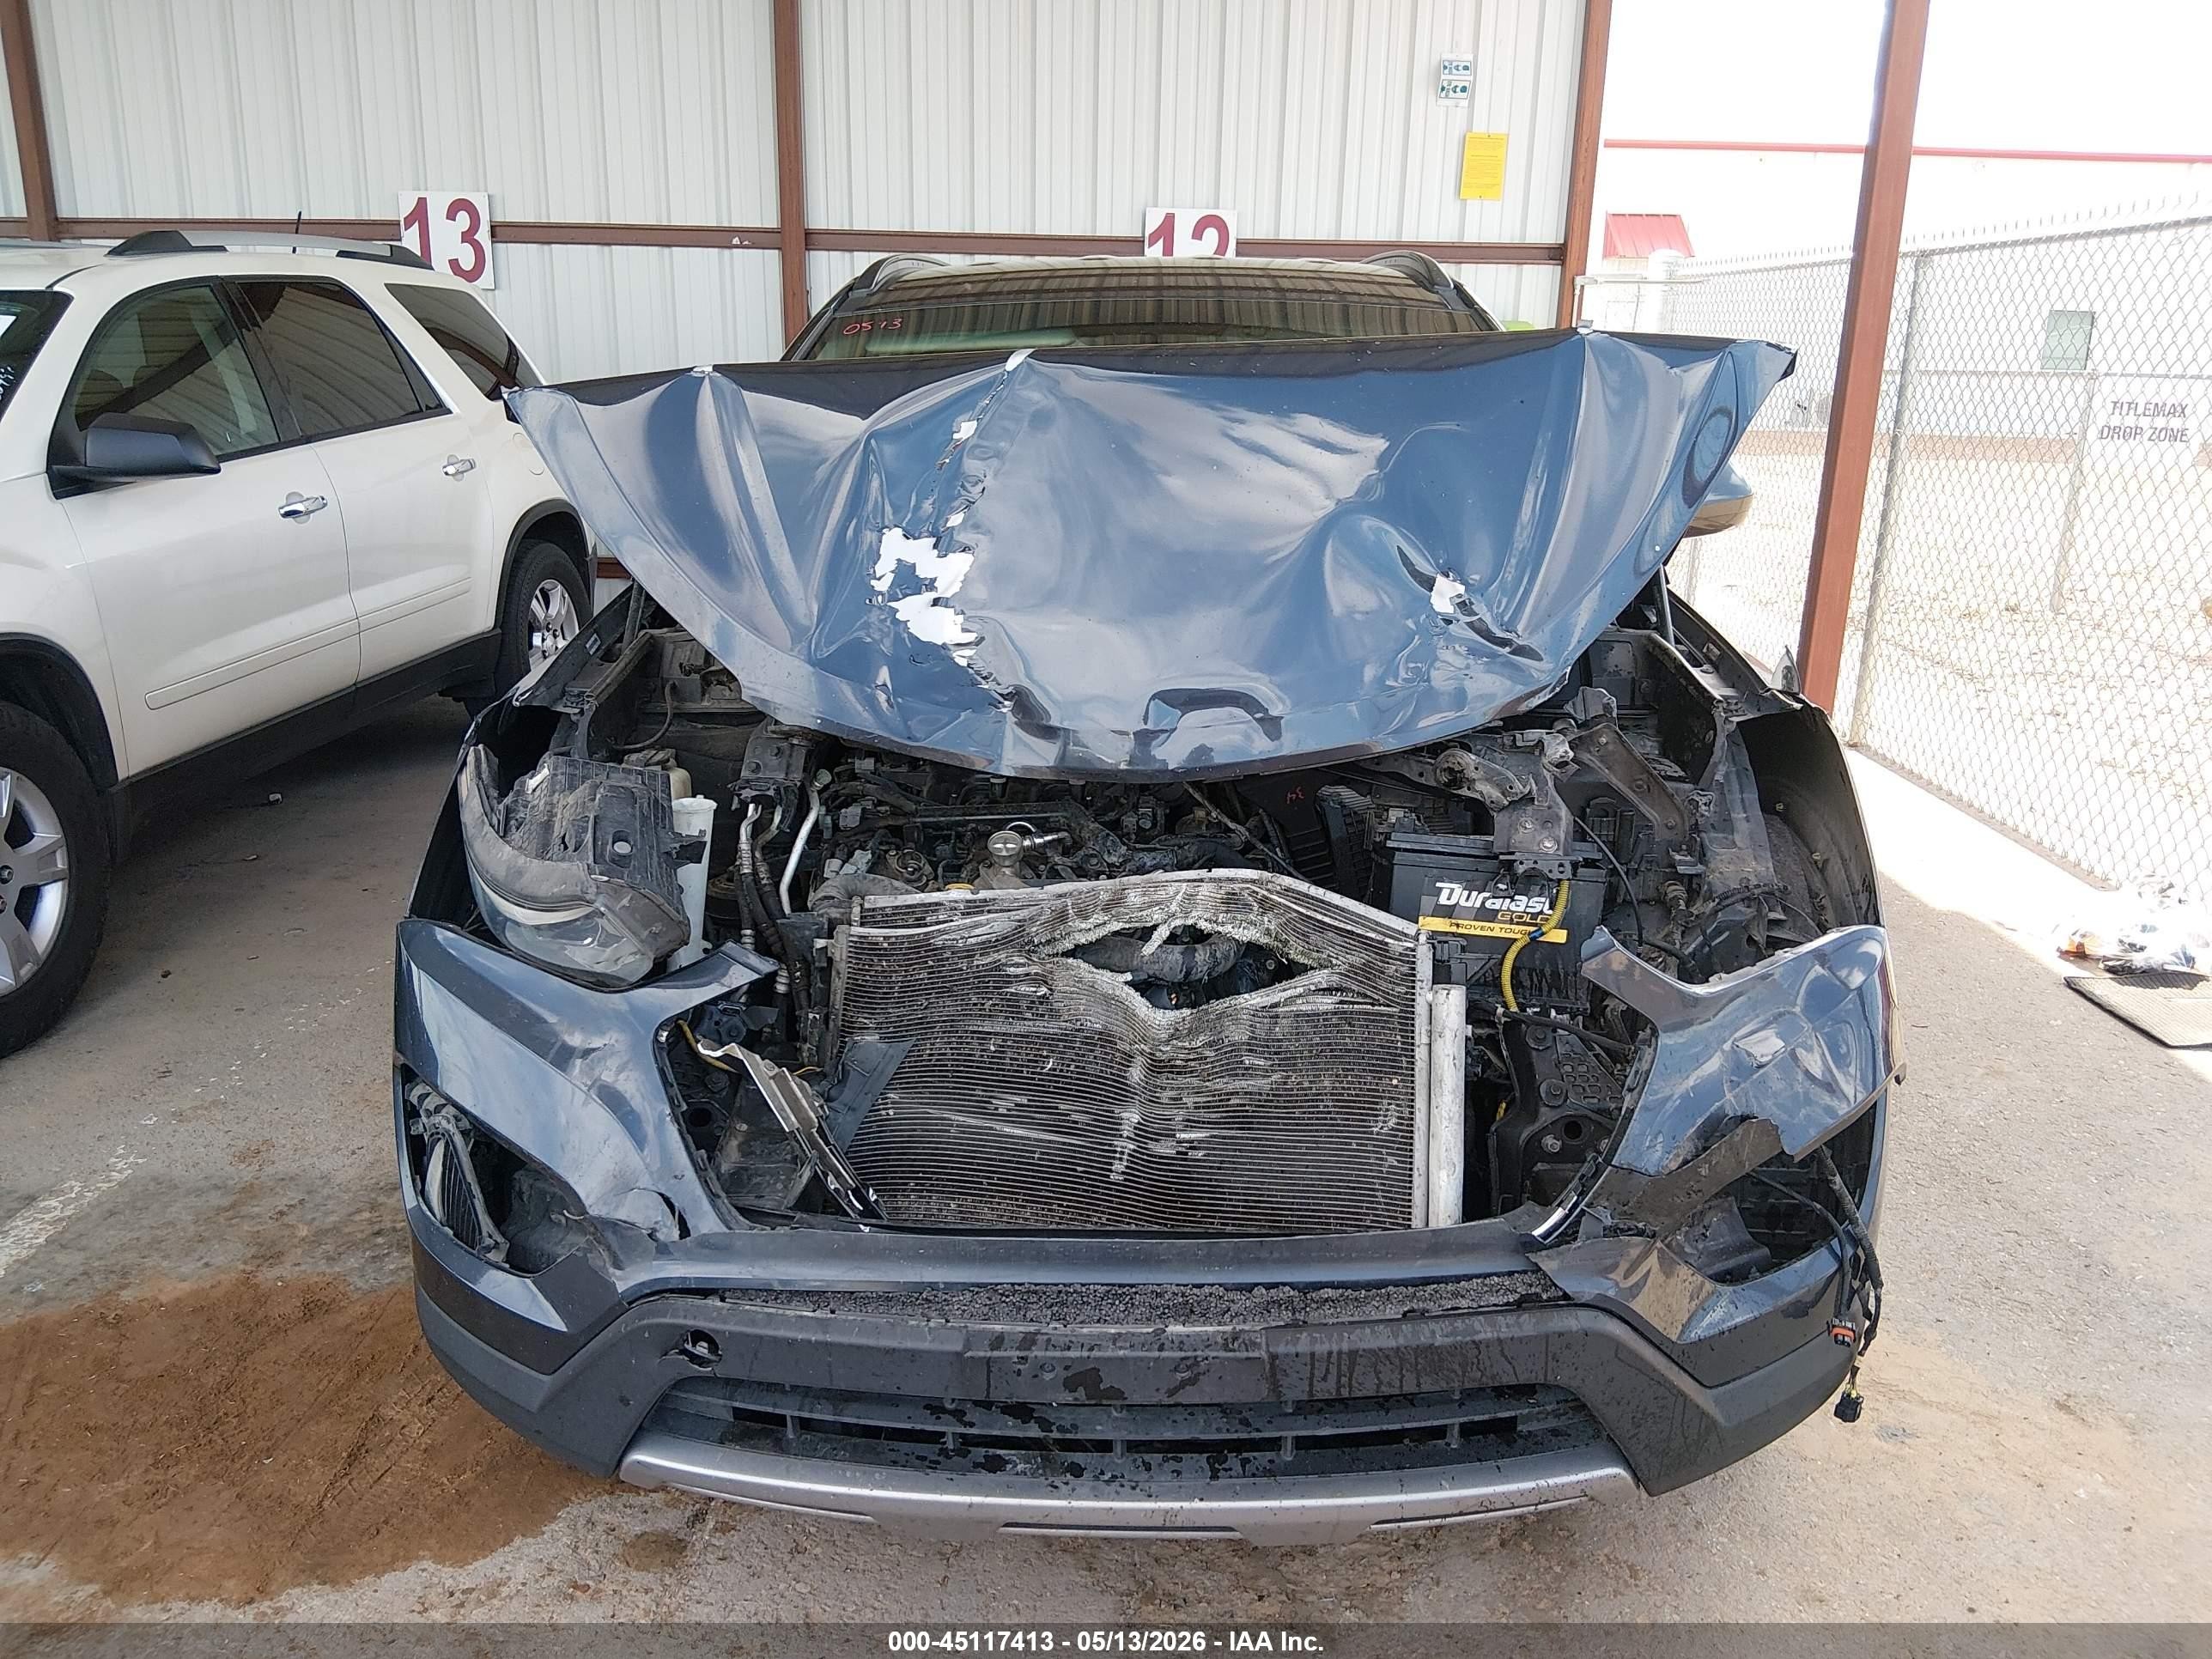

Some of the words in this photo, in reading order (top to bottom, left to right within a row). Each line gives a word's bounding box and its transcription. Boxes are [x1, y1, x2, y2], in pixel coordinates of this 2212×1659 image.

[404, 197, 486, 283] 13
[2111, 400, 2189, 418] TITLEMAX
[2100, 425, 2144, 441] DROP
[2148, 427, 2190, 443] ZONE
[1449, 921, 1496, 933] PROVEN
[1498, 927, 1532, 936] TOUG
